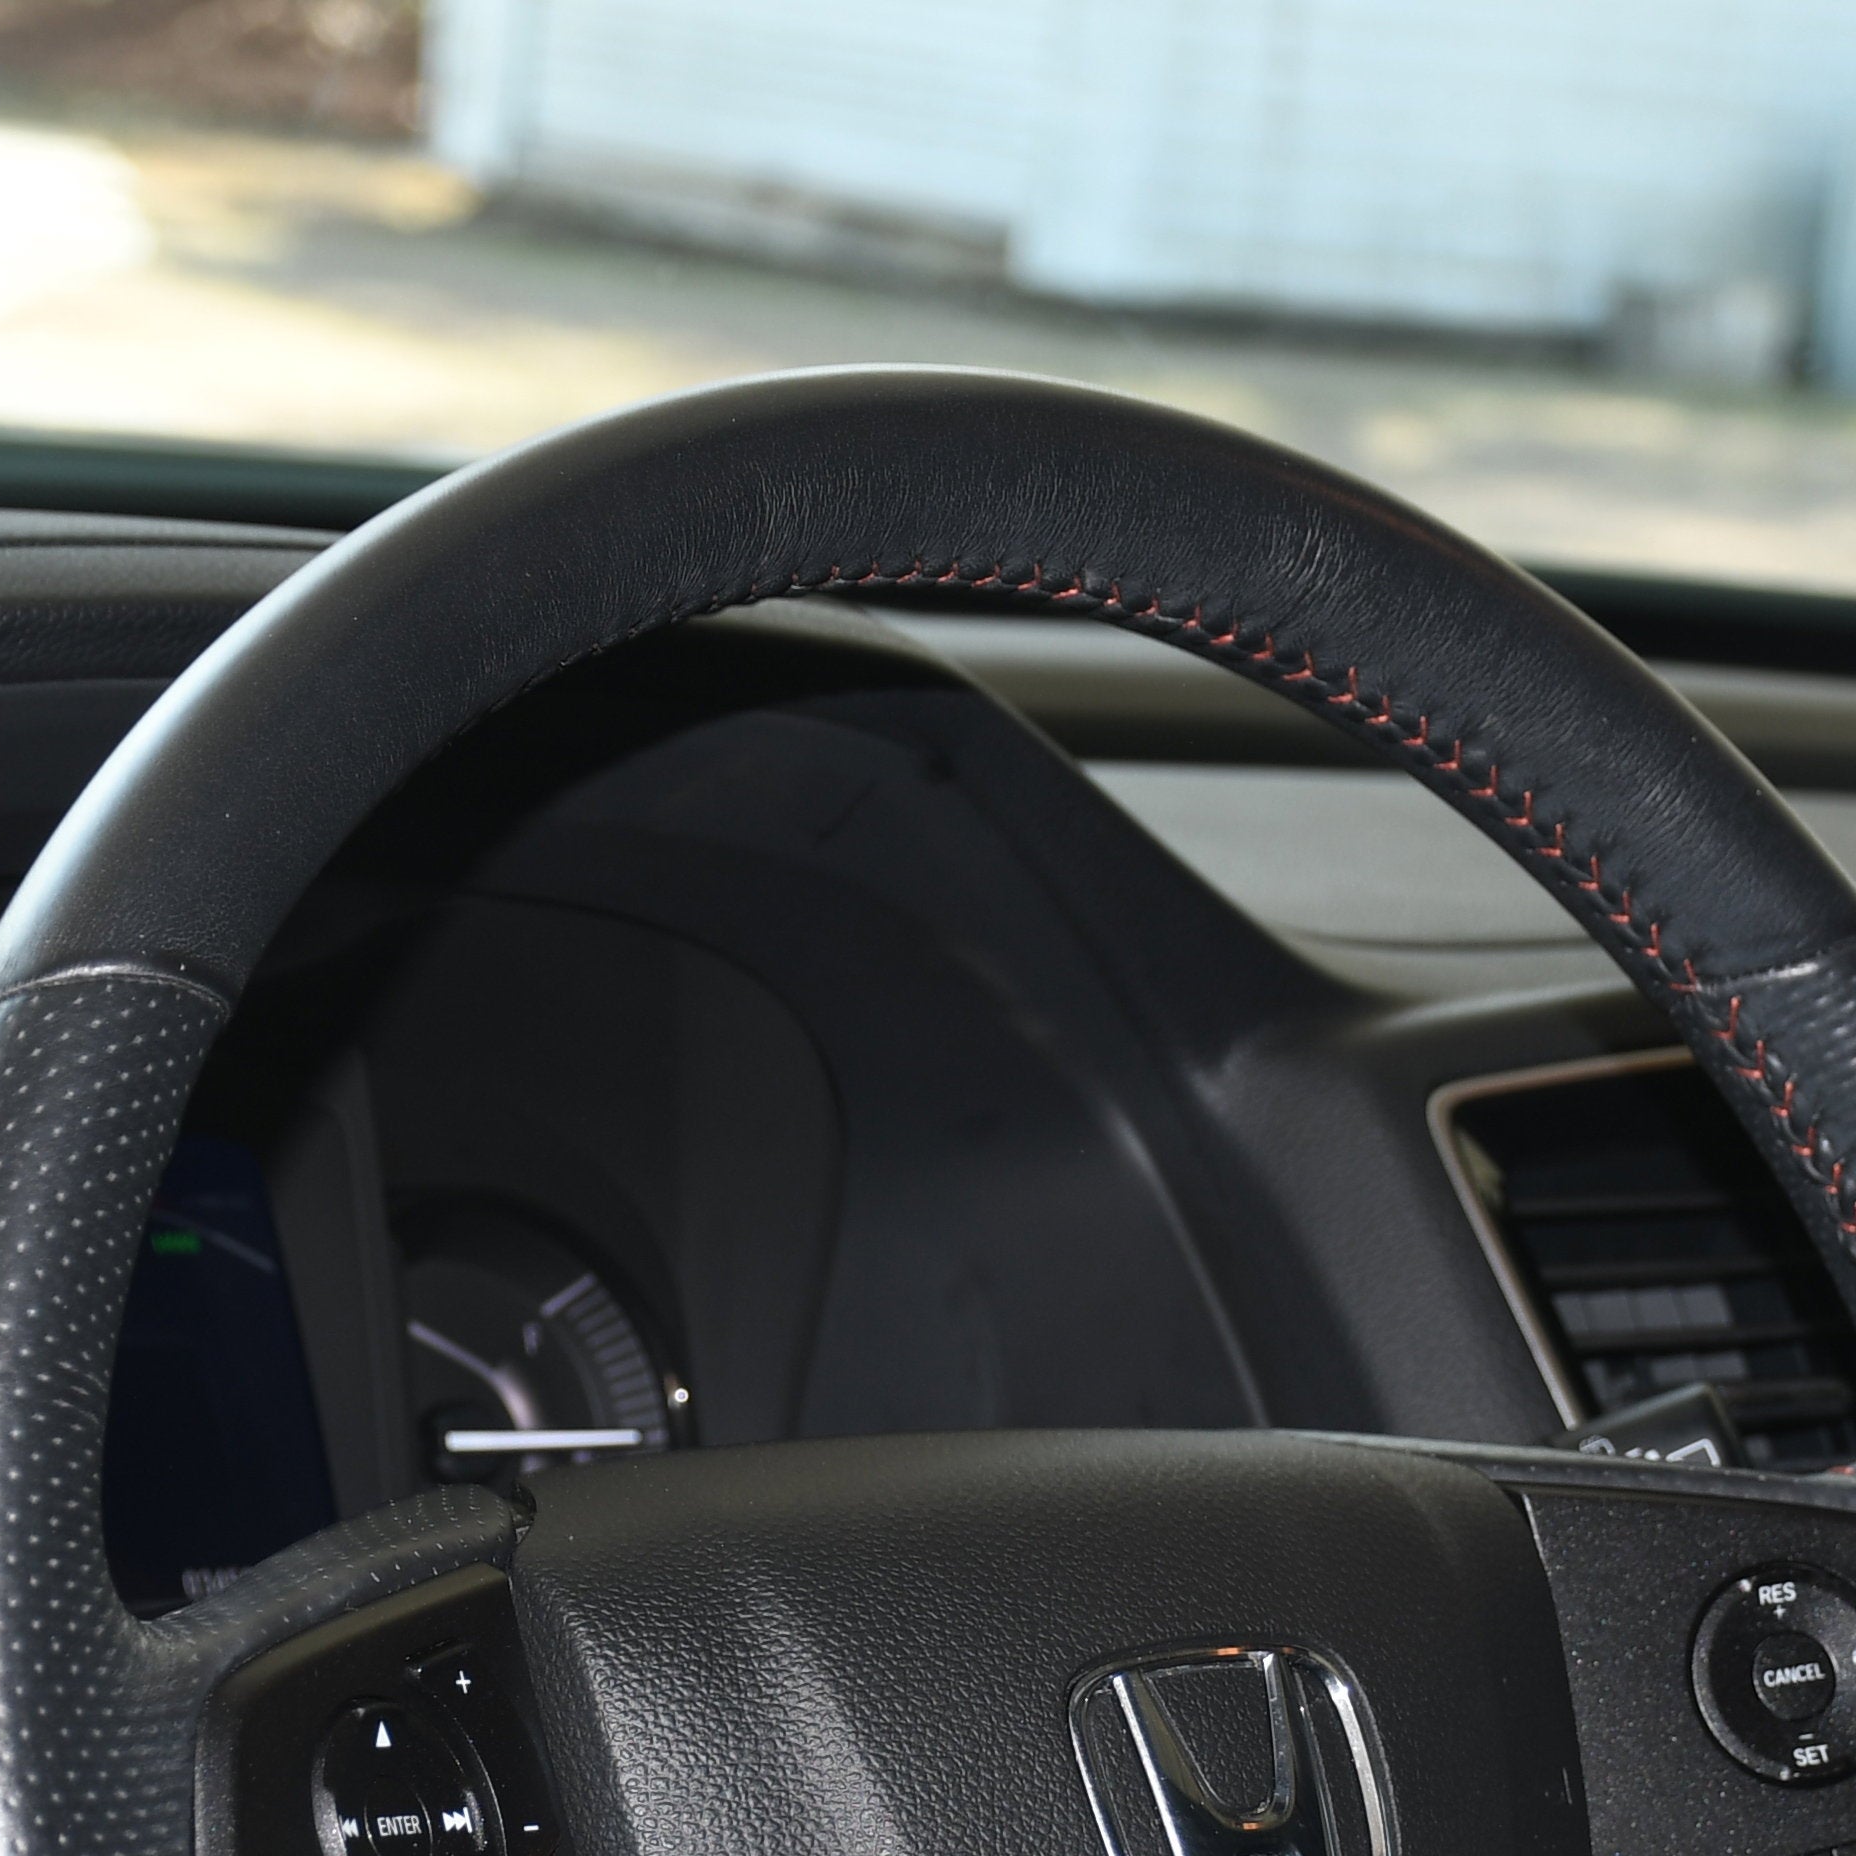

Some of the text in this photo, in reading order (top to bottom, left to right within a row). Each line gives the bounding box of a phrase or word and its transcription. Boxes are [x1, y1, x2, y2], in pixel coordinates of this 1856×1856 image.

[1757, 1580, 1797, 1606] RES
[1762, 1662, 1826, 1688] CANCEL
[1792, 1743, 1830, 1768] SET
[376, 1813, 422, 1838] ENTER
